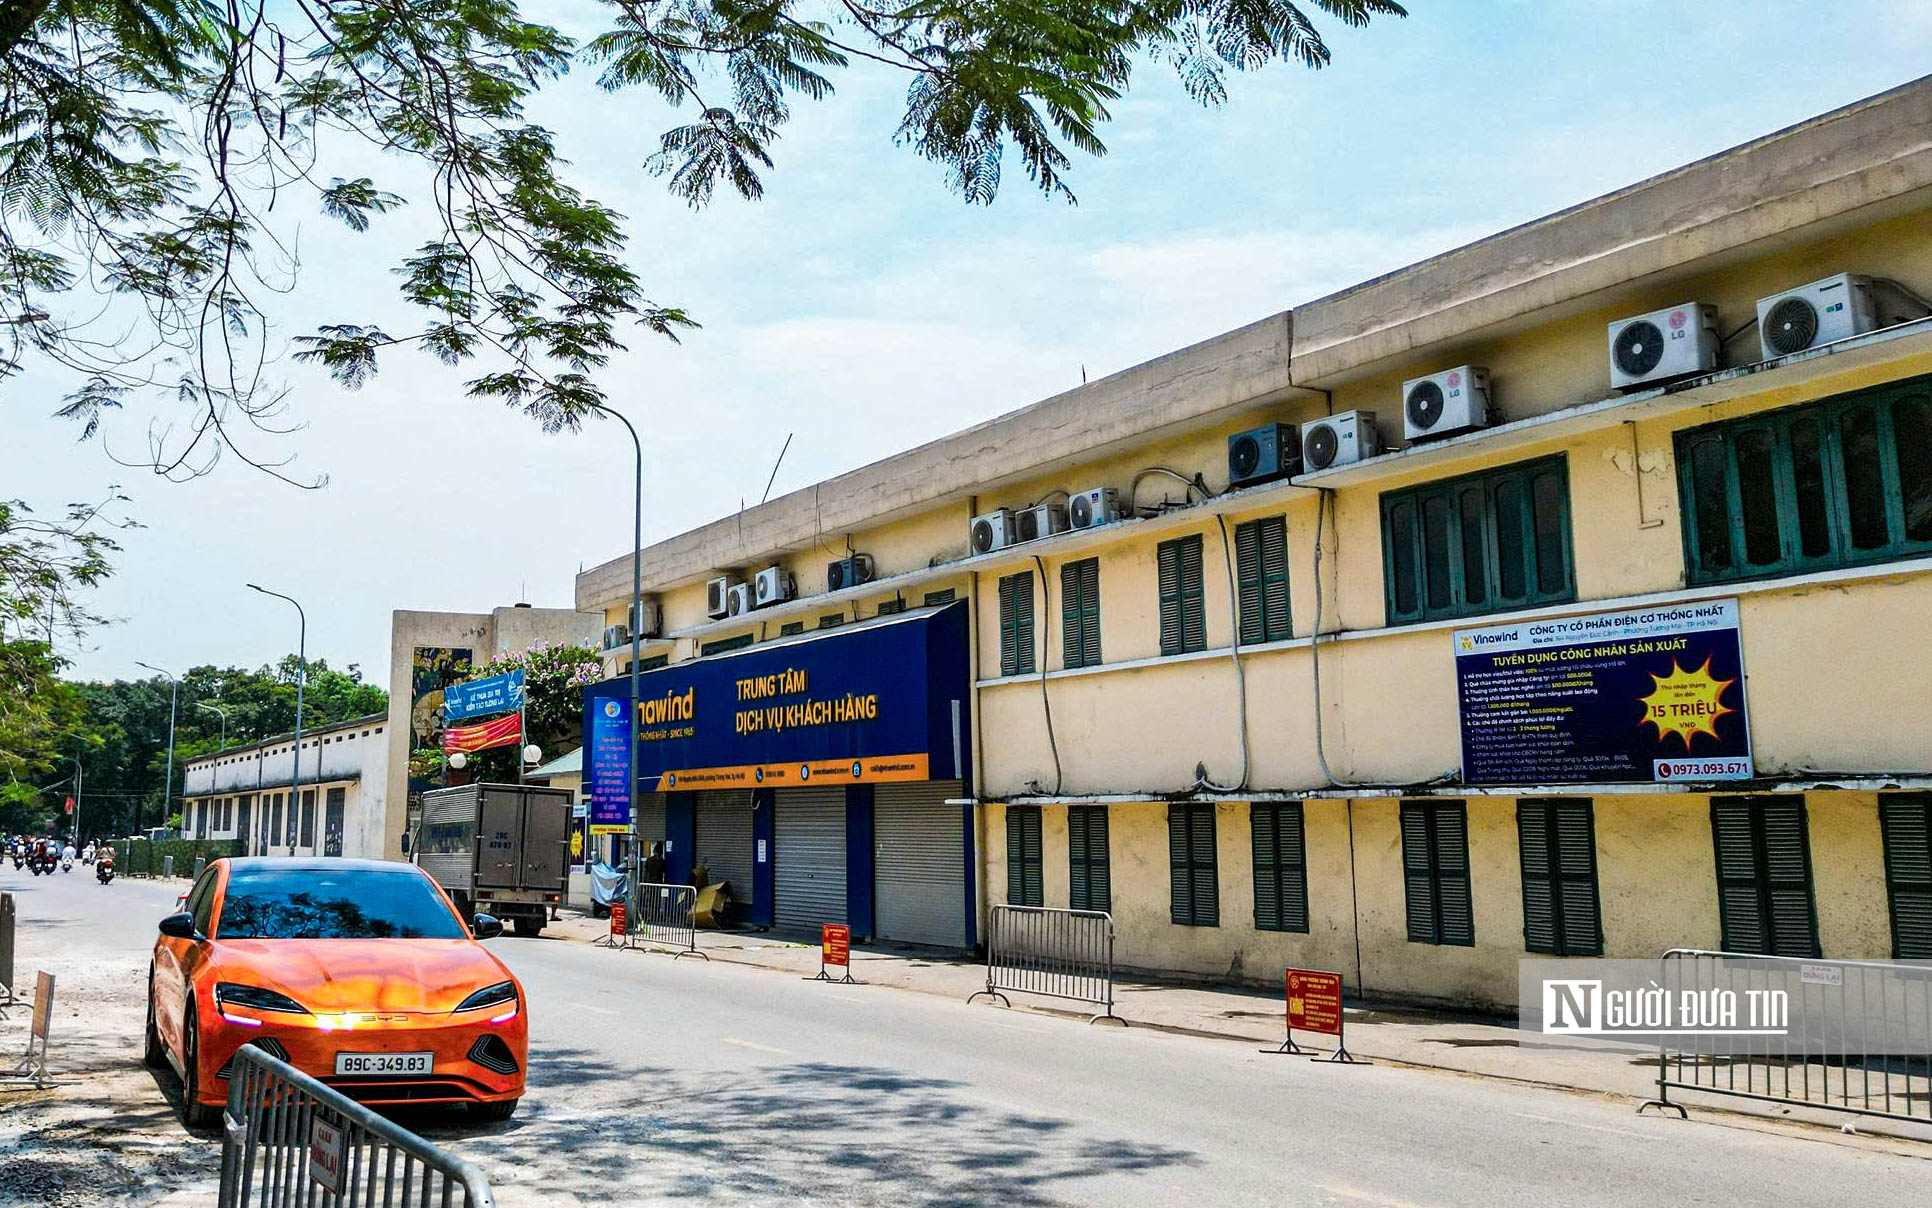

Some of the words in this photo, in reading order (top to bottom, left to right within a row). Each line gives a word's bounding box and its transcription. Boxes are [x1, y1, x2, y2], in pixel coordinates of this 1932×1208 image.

[1671, 330, 1685, 340] LG
[1449, 388, 1460, 398] LG
[1529, 624, 1555, 636] CÔNG
[1557, 624, 1568, 633] TY
[1640, 612, 1655, 624] CƠ
[1657, 607, 1693, 622] THỐNG
[1695, 604, 1724, 617] NHẤT
[1473, 631, 1518, 645] Vinawind
[1527, 652, 1558, 665] DỤNG
[1560, 646, 1592, 660] CÔNG
[1594, 643, 1627, 657] NHÂN
[1656, 636, 1688, 651] XUẤT
[736, 674, 776, 701] TRUNG
[778, 668, 806, 695] TÂM
[736, 708, 764, 736] DỊCH
[766, 706, 783, 733] VỤ
[786, 698, 832, 728] KHÁCH
[835, 692, 876, 722] HÀNG
[1651, 706, 1666, 718] 15
[1670, 699, 1718, 720] TRIỆU
[1673, 763, 1748, 775] 0973.093.671
[344, 1058, 425, 1071] 89C-349.83
